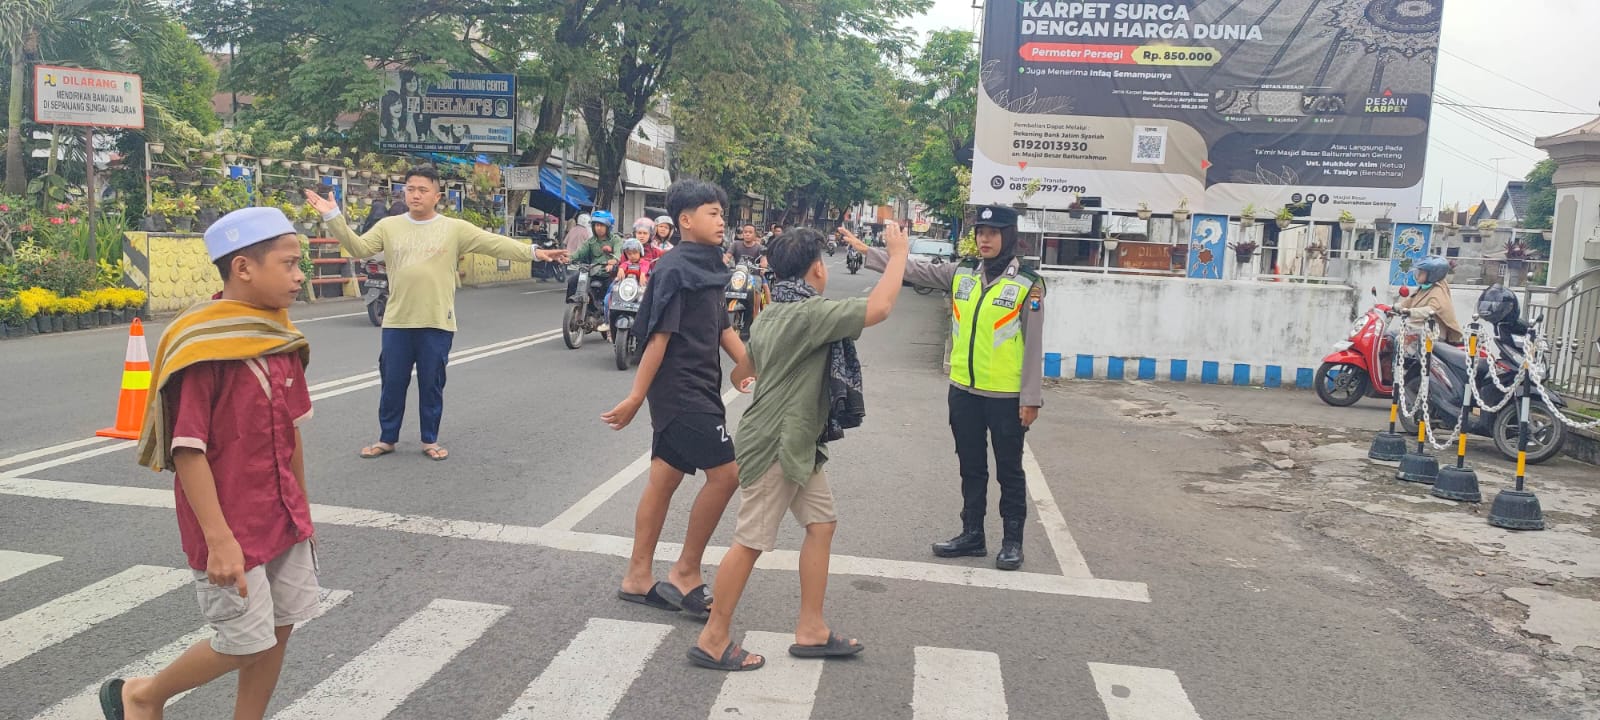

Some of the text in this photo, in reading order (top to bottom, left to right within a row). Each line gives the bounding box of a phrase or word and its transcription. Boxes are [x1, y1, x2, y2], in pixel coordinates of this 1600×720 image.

[1022, 1, 1190, 21] KARPET SURGA
[1021, 20, 1263, 41] DENGAN HARGA DUNIA
[1031, 47, 1213, 62] Permeter Persegi Rp. 850.000
[1026, 67, 1172, 80] Juga Menerima Infaq Semampunya
[62, 76, 117, 88] DILARANG
[486, 80, 508, 91] CENTER
[56, 90, 124, 103] MENDIRIKAN BANGUNAN
[1366, 97, 1408, 106] DESAIN
[43, 100, 50, 109] DI
[50, 101, 85, 111] SEPANJANG
[86, 103, 107, 113] SUNGAI
[111, 106, 137, 115] SALURAN
[1365, 105, 1407, 113] KARPET
[1013, 131, 1043, 139] Rekening
[1012, 139, 1088, 152] 6192013930
[1349, 145, 1384, 153] Langsung
[1276, 150, 1300, 158] Masjid
[1371, 152, 1403, 160] Genteng
[1379, 162, 1406, 170] (Ketua)
